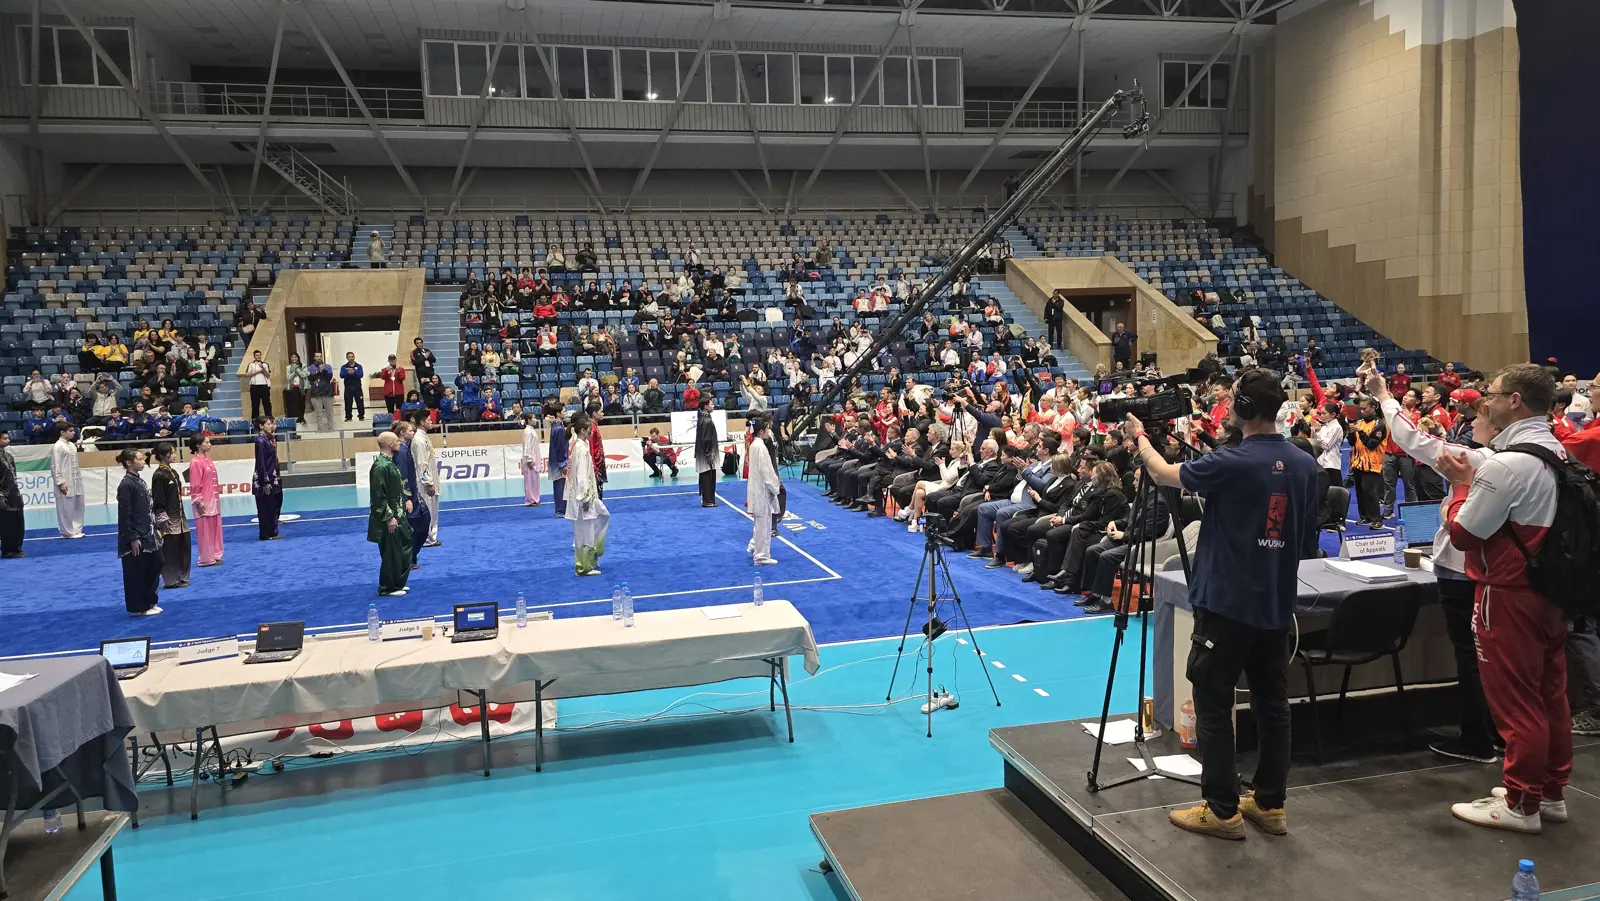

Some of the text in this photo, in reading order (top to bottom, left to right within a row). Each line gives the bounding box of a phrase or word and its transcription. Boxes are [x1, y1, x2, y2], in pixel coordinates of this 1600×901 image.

[441, 449, 488, 459] SUPPLIER
[1257, 538, 1285, 548] WUSHU
[196, 647, 215, 655] Judge
